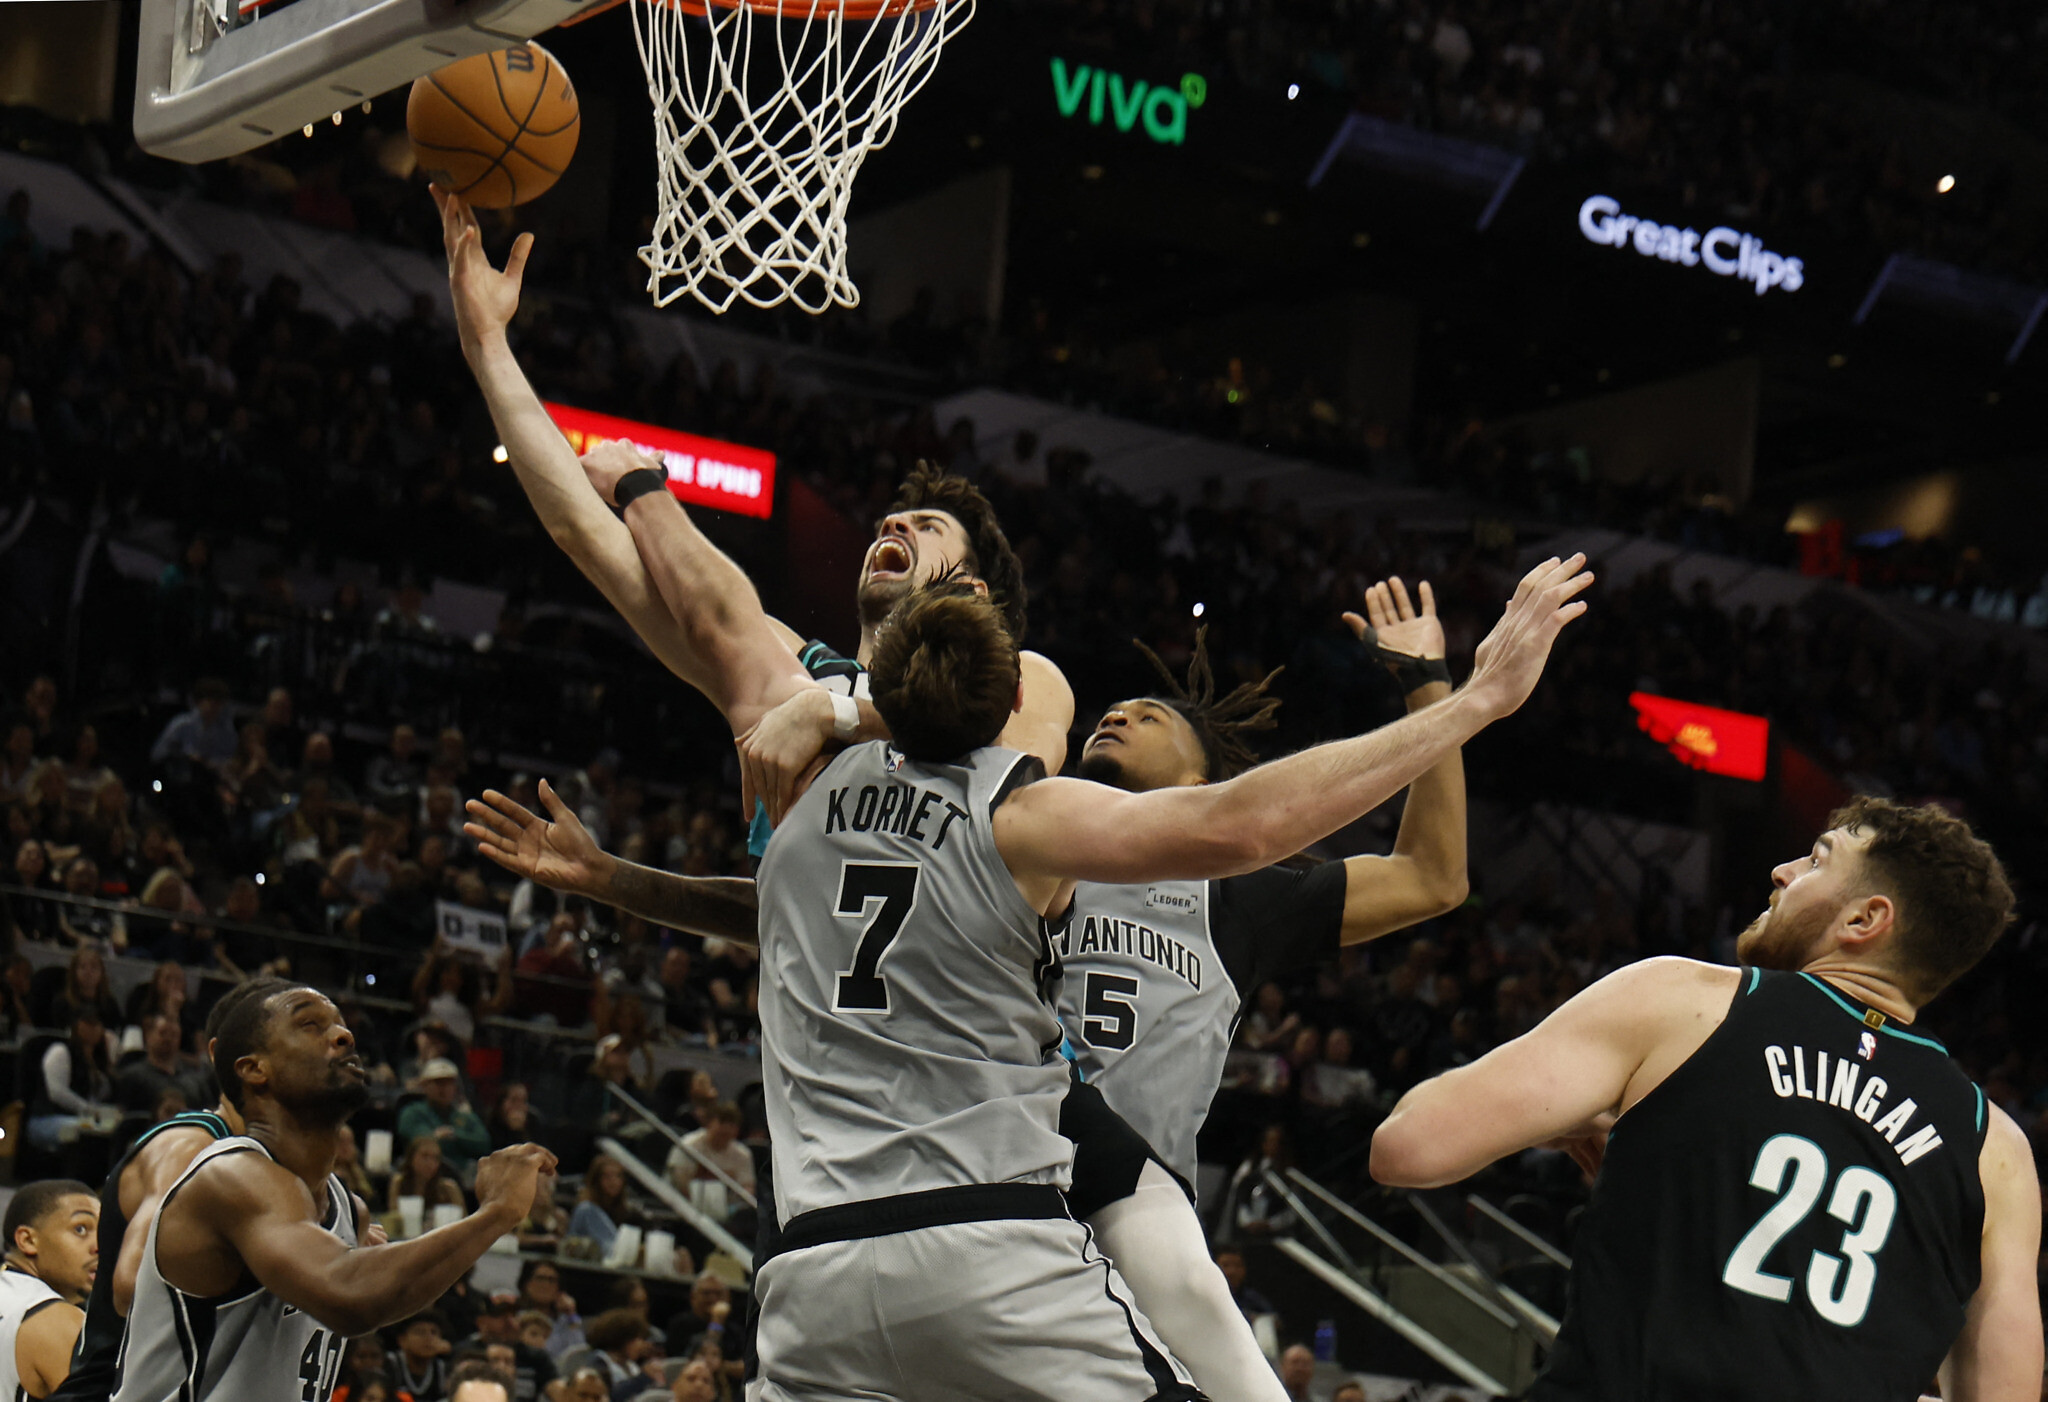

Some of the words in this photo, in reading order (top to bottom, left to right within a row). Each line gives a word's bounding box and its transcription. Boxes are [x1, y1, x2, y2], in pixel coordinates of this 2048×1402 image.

[1579, 195, 1700, 267] Great
[1701, 226, 1804, 296] Clips
[825, 785, 969, 850] KORNET
[831, 859, 922, 1015] 7
[1153, 894, 1191, 909] LEDGER
[1077, 915, 1202, 995] ANTONIO
[1081, 970, 1140, 1053] 5
[1764, 1045, 1943, 1166] CLINGAN
[1722, 1133, 1898, 1328] 23
[298, 1327, 348, 1402] 40
